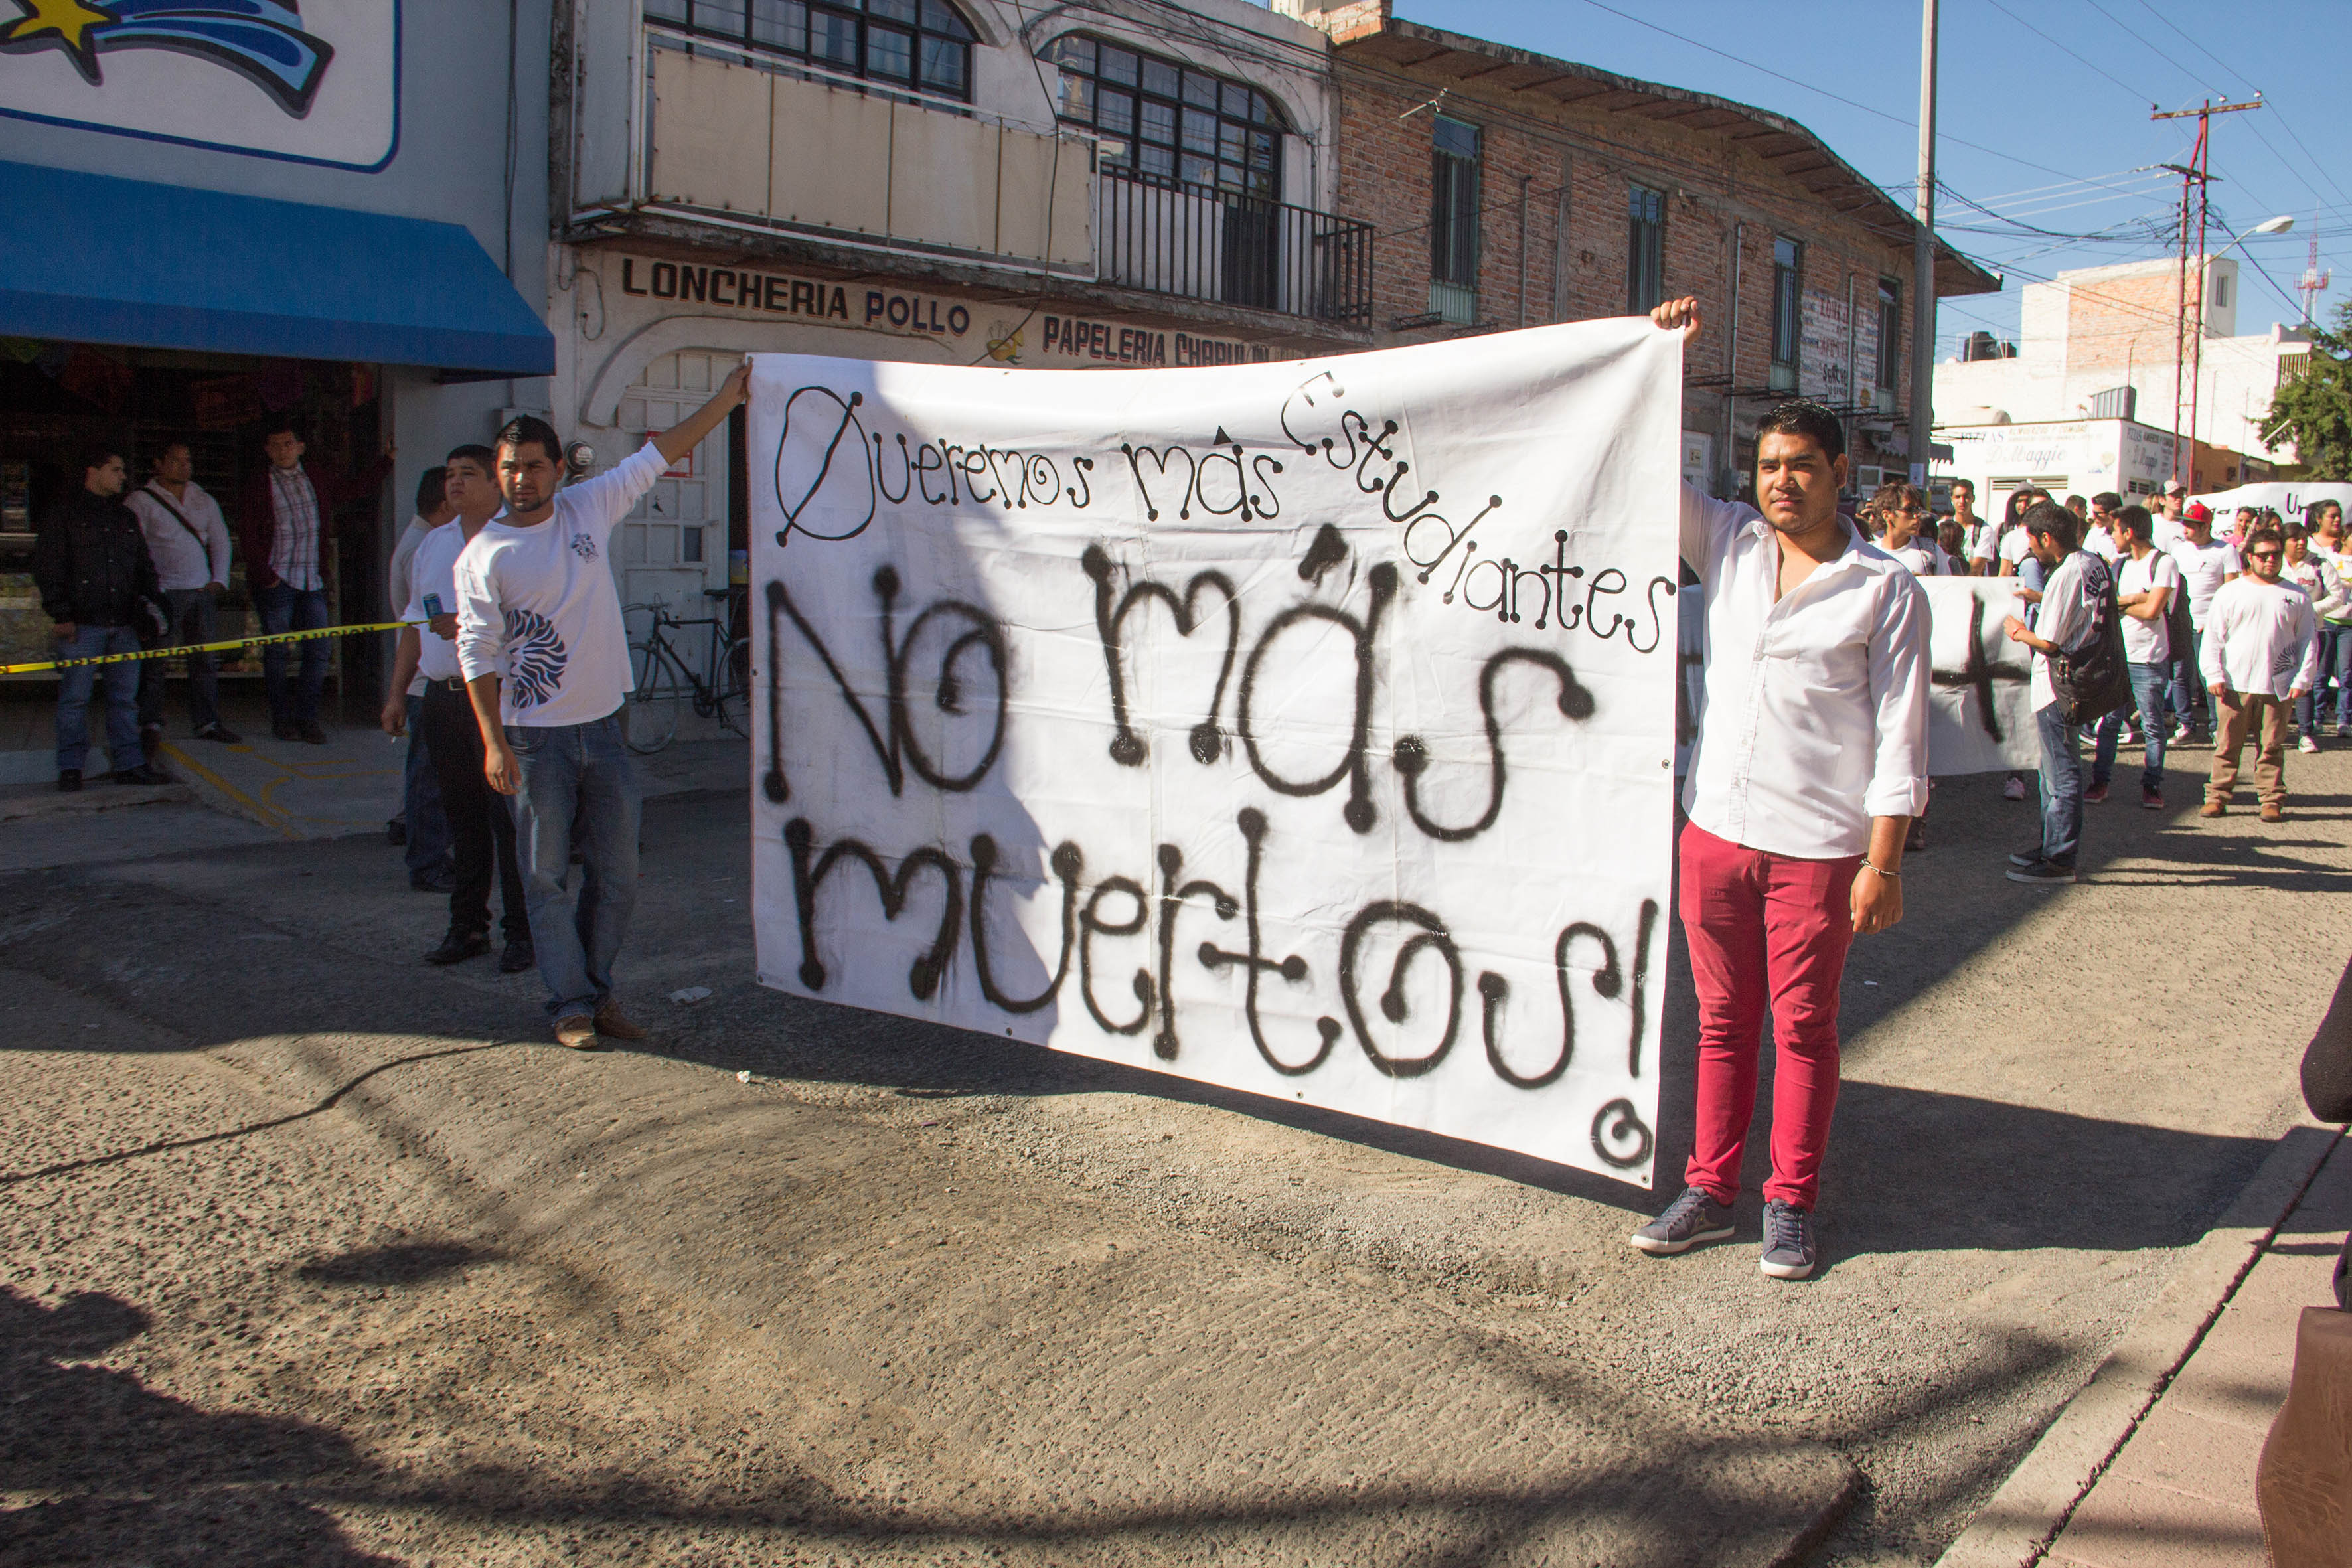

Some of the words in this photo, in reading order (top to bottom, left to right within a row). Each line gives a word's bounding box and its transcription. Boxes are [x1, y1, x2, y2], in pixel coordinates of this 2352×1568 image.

[622, 258, 849, 321] LONCHERIA
[864, 291, 969, 337] POLLO
[1042, 315, 1166, 367] PAPELERIA
[775, 386, 1094, 548] Queremos
[1120, 425, 1283, 522] más
[1281, 370, 1676, 654] Estudiantes
[1080, 522, 1595, 843] más
